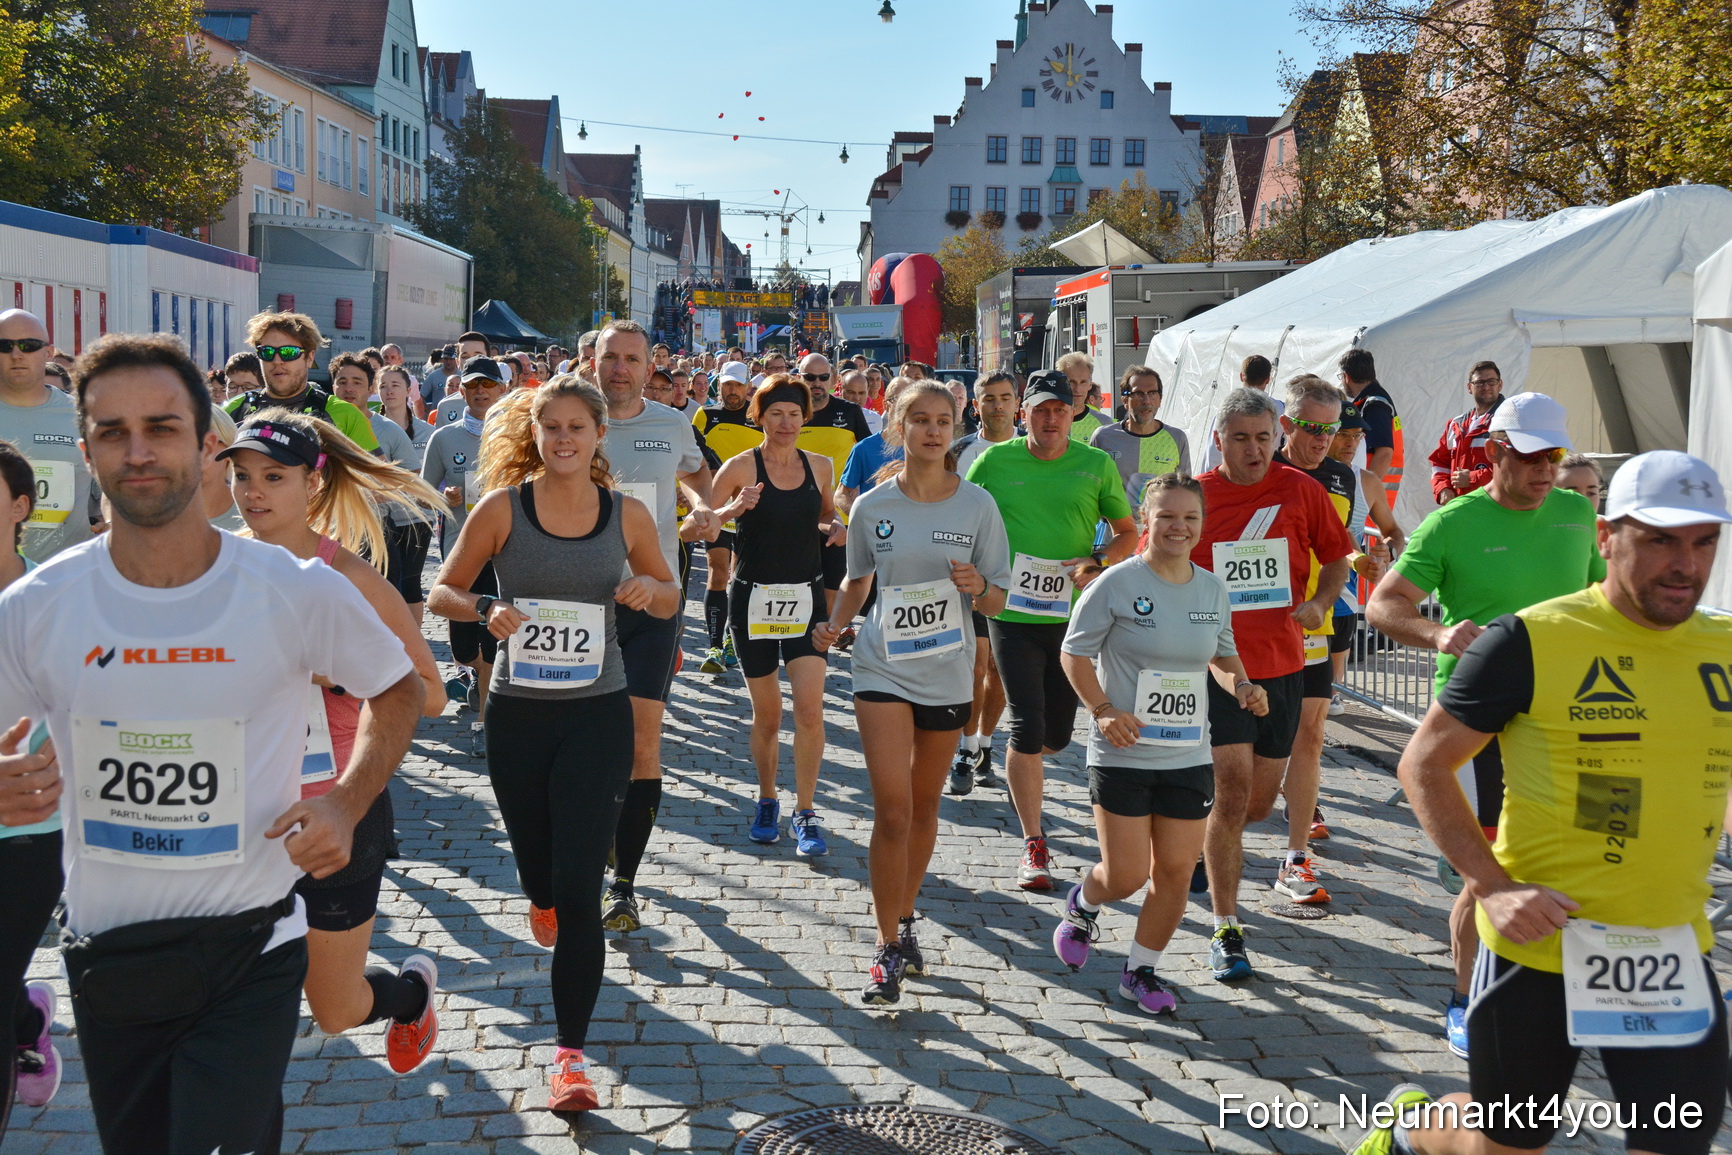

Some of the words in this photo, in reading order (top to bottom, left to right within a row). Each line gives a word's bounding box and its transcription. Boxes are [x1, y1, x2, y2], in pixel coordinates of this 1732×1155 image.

[725, 294, 760, 304] START
[34, 434, 75, 444] BOCK
[634, 440, 672, 451] BOCK
[1242, 513, 1264, 540] chneider
[932, 531, 973, 545] BOCK
[1234, 545, 1267, 555] BOCK
[1031, 562, 1059, 574] BOCK
[1225, 558, 1278, 582] 2618
[1020, 571, 1064, 593] 2180
[903, 588, 937, 600] BOCK
[1239, 592, 1269, 603] Jürgen
[765, 600, 798, 616] 177
[1026, 600, 1052, 610] Helmut
[538, 608, 578, 620] BOCK
[893, 600, 948, 629] 2067
[1189, 612, 1219, 621] BOCK
[770, 625, 790, 634] Birgit
[918, 626, 940, 634] Neumarkt
[523, 624, 590, 653] 2312
[914, 638, 937, 650] Rosa
[123, 647, 236, 664] KLEBL
[539, 667, 570, 679] Laura
[1161, 679, 1190, 688] BOCK
[1147, 692, 1196, 716] 2069
[1568, 705, 1648, 722] Reebok
[1160, 728, 1181, 739] Lena
[119, 732, 192, 749] BOCK
[99, 758, 218, 806] 2629
[85, 788, 91, 798] C
[110, 808, 142, 820] PARTL
[144, 812, 194, 822] Neumarkt
[132, 831, 184, 852] Bekir
[1585, 953, 1684, 993] 2022
[1595, 996, 1625, 1005] PARTL
[1622, 1015, 1657, 1032] Erik
